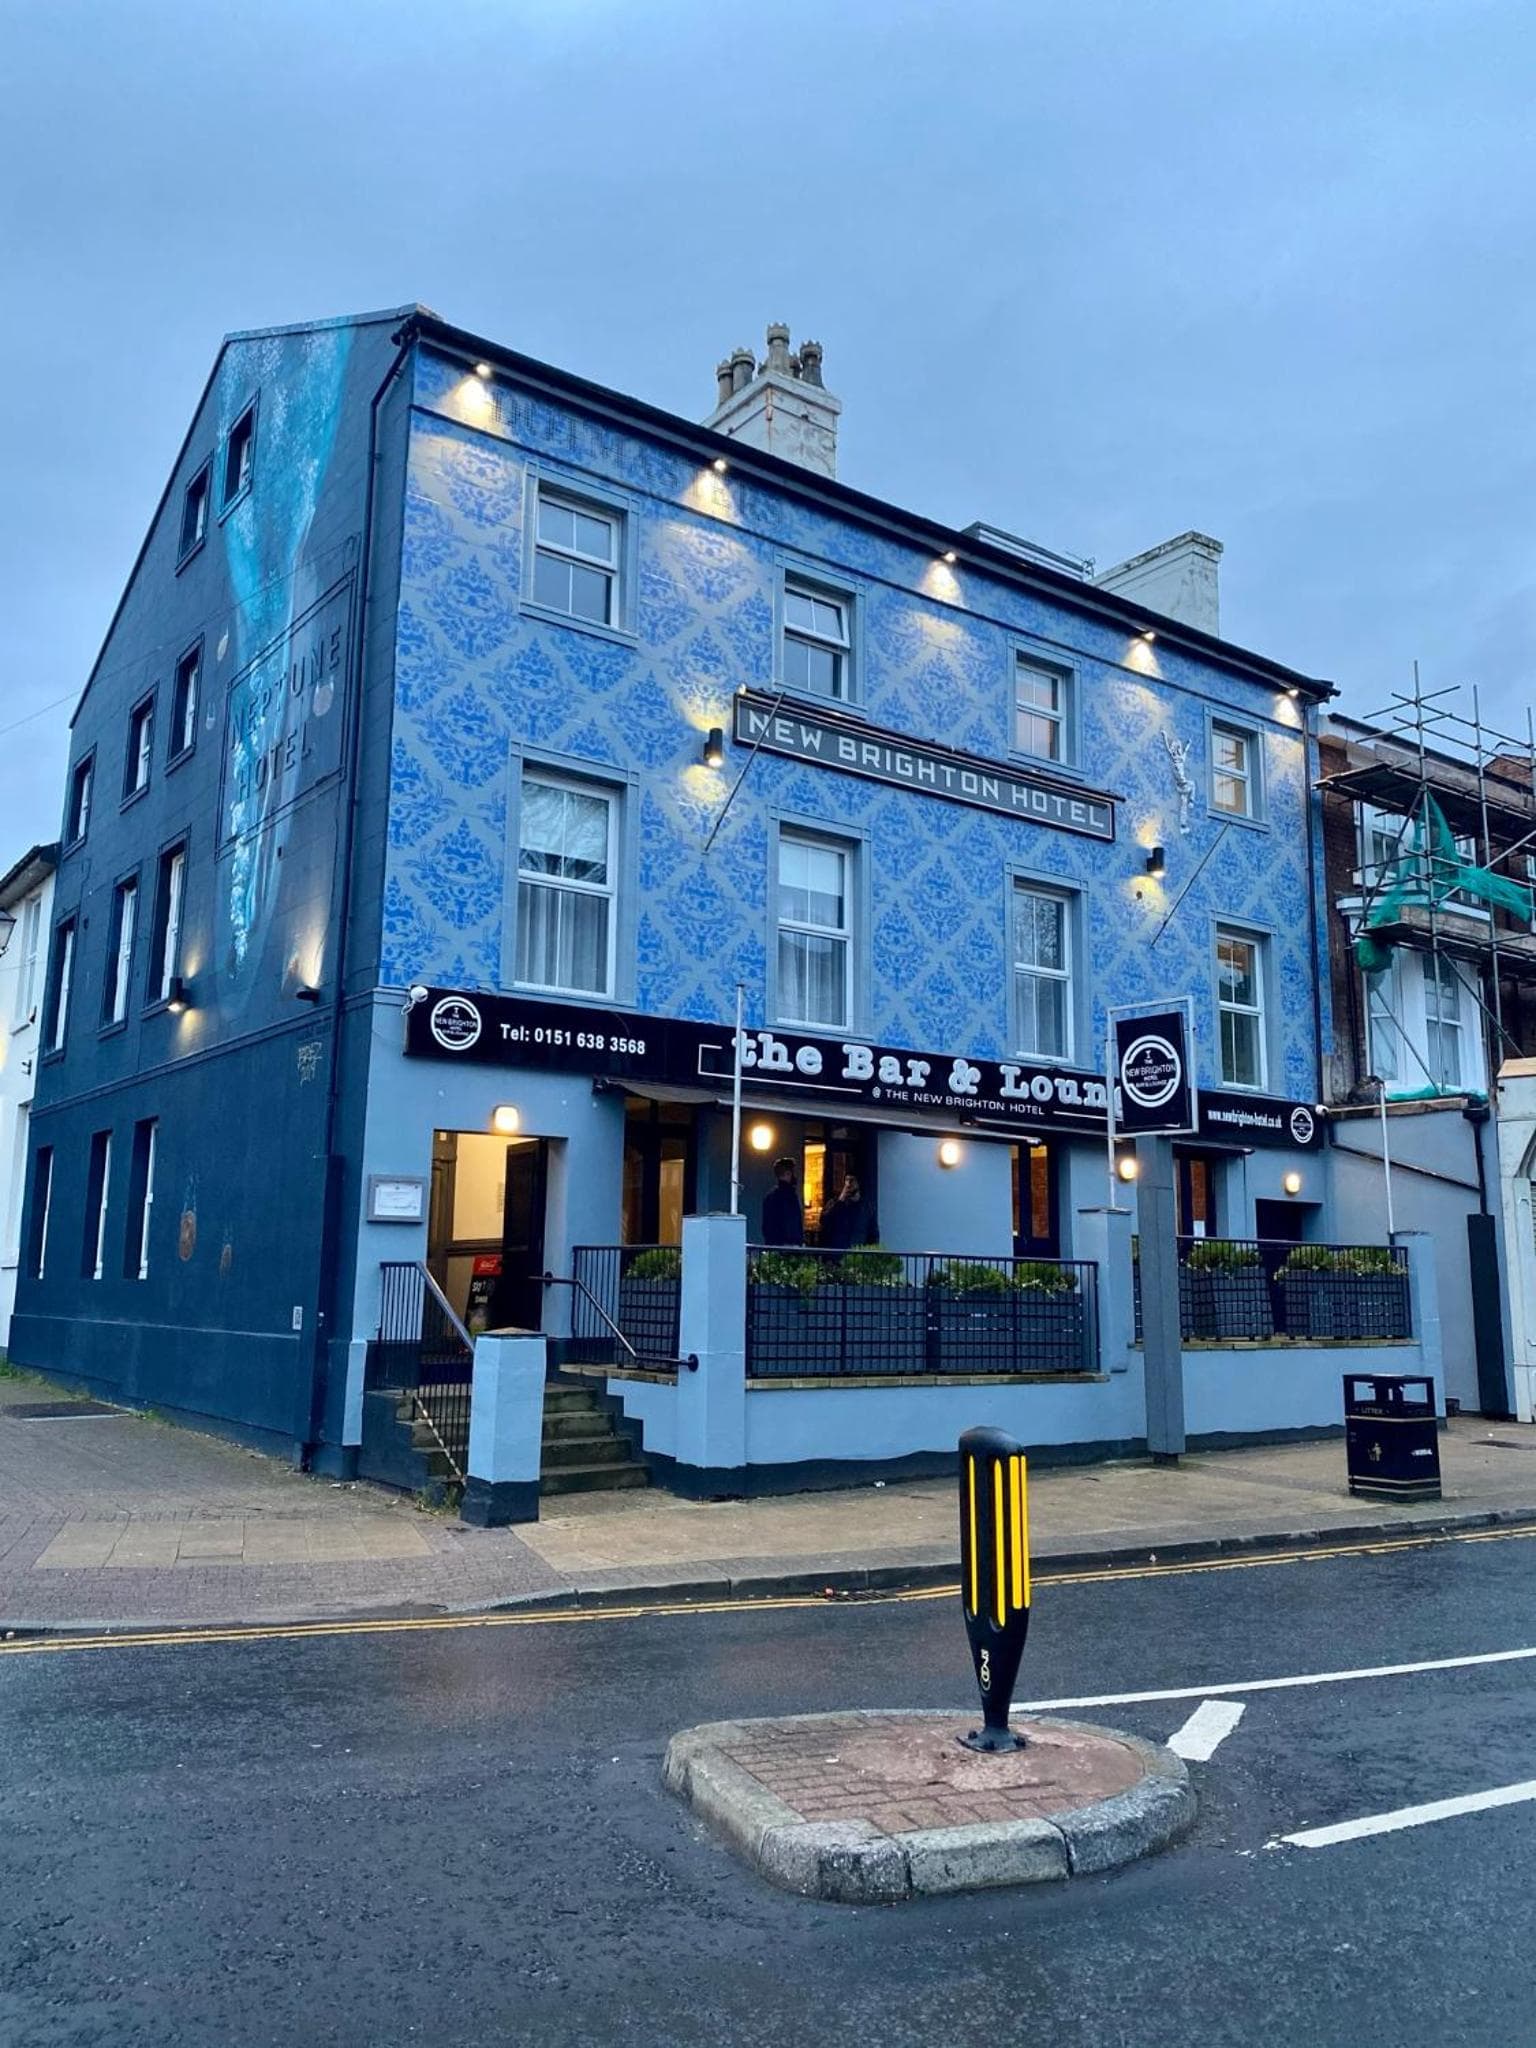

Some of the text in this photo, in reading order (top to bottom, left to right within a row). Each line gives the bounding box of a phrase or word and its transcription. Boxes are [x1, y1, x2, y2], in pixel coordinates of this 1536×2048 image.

[231, 625, 342, 751] NEPTUNE
[239, 721, 312, 802] HOTEL
[748, 708, 1104, 830] NEW BRIGHTON HOTEL
[500, 1023, 646, 1055] Tel: 0151 638 3568
[731, 1030, 823, 1075] the
[842, 1043, 931, 1087] Bar
[949, 1058, 981, 1095] &
[886, 1088, 909, 1101] THE
[913, 1092, 943, 1105] NEW
[945, 1096, 1005, 1113] BRIGHTON
[1009, 1102, 1045, 1116] HOTEL
